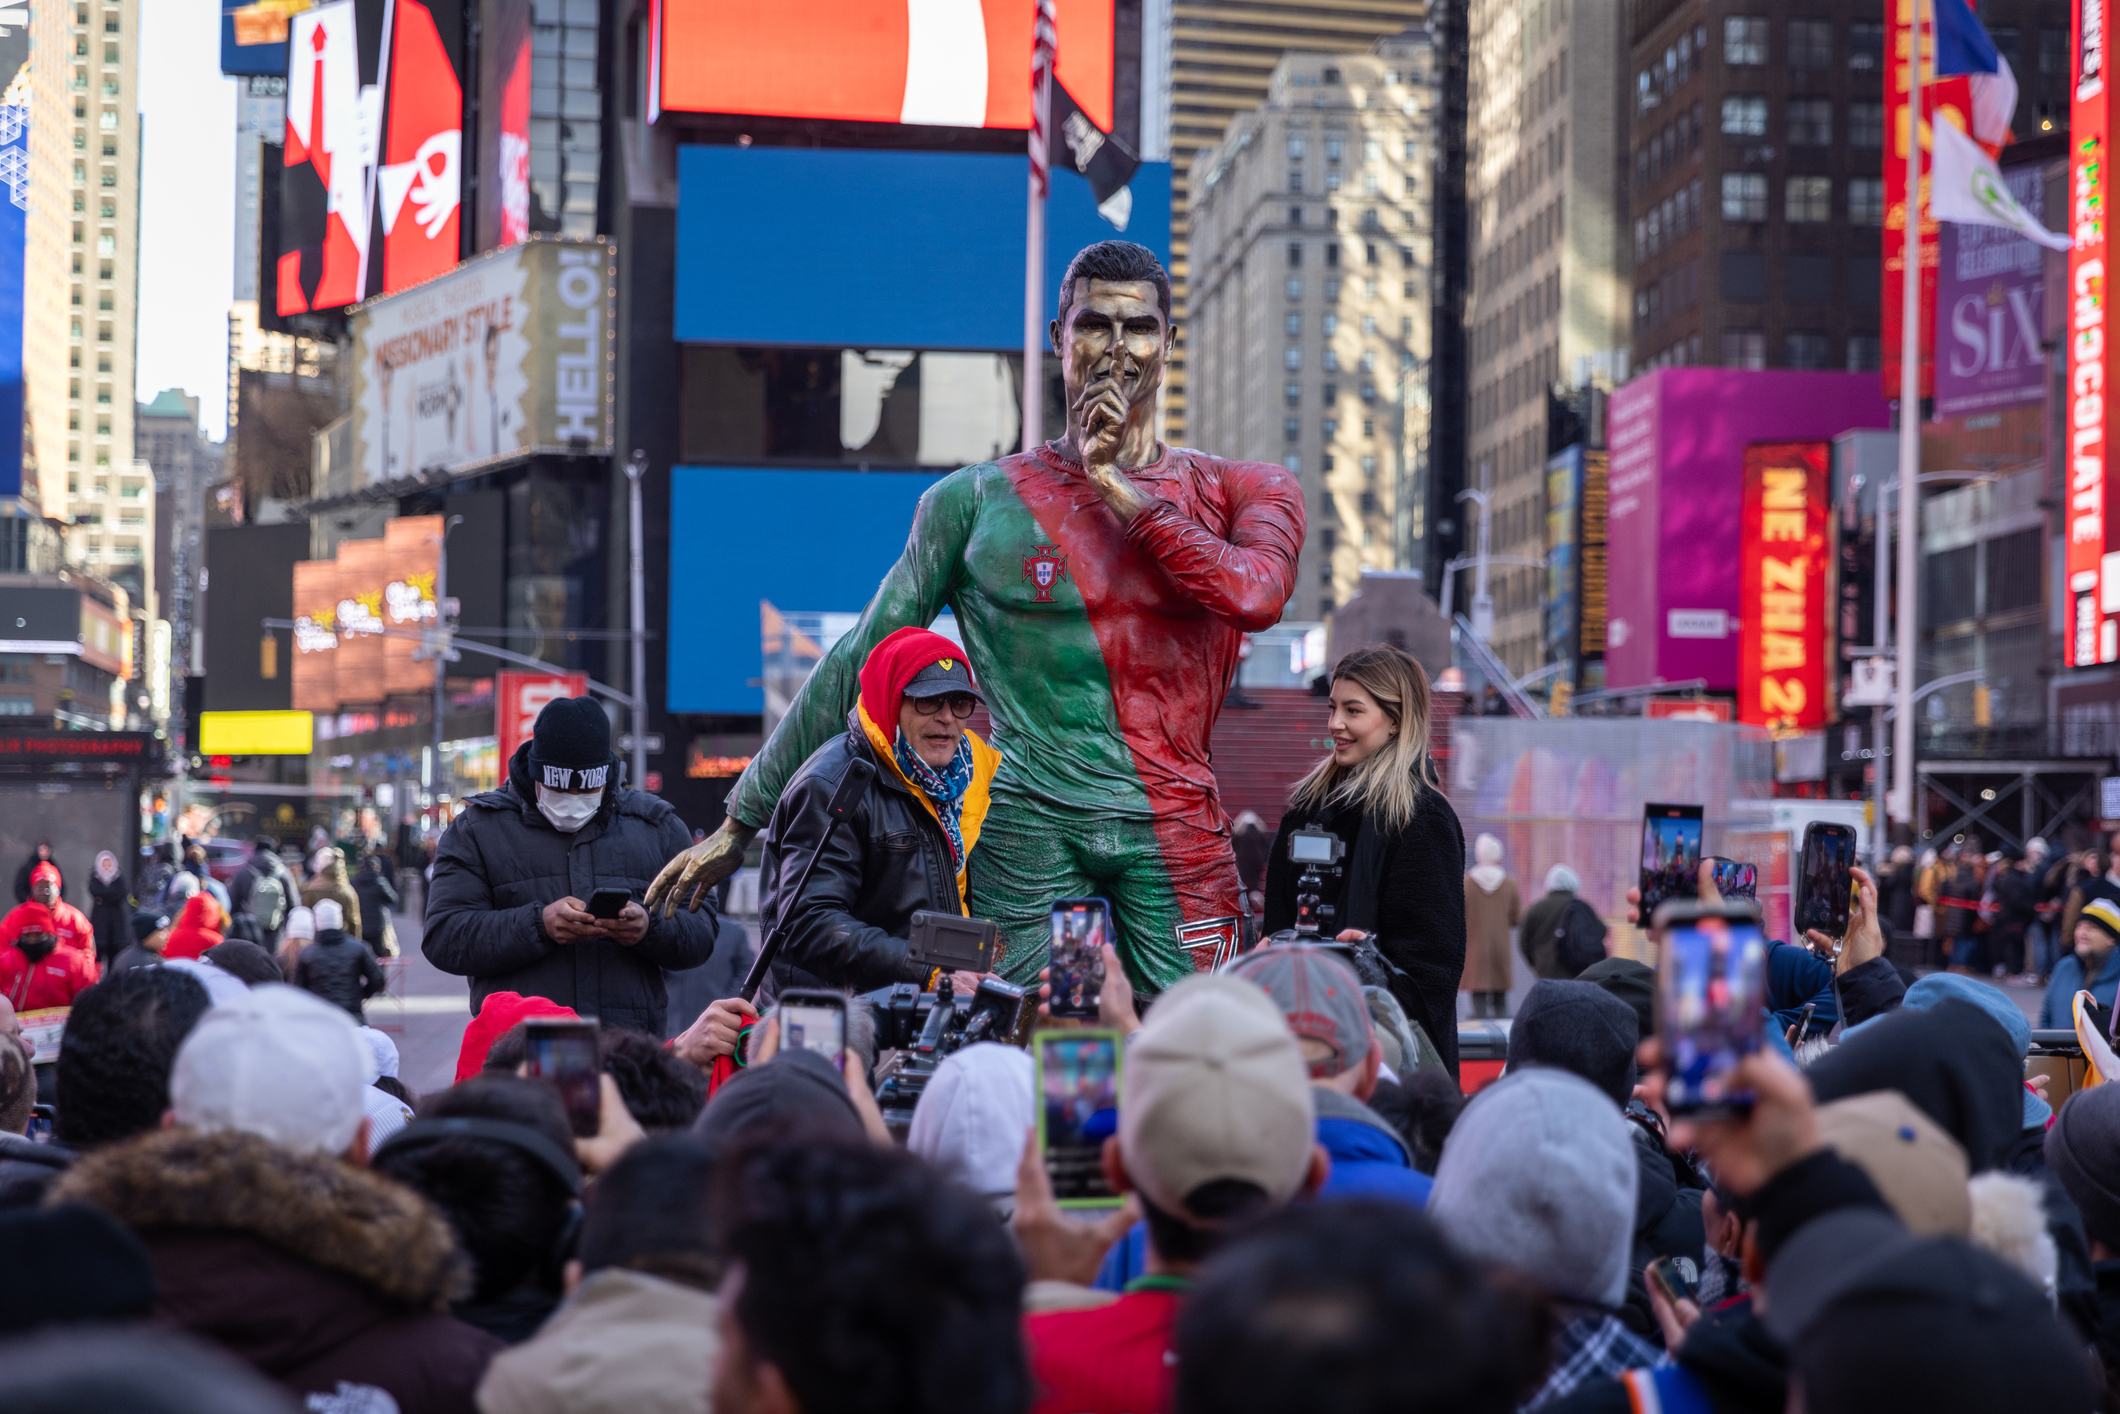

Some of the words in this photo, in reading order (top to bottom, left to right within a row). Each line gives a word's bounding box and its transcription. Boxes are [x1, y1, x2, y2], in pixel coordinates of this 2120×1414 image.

[555, 249, 602, 442] HELLO!
[2072, 257, 2104, 546] CHOCOLATE
[1761, 467, 1808, 542] NE
[1760, 555, 1807, 672] ZHA
[1760, 675, 1807, 714] 2
[25, 737, 144, 756] PHOTOGRAPHY
[543, 764, 573, 790] NEW
[577, 764, 610, 790] YORK
[1175, 916, 1237, 978] 7
